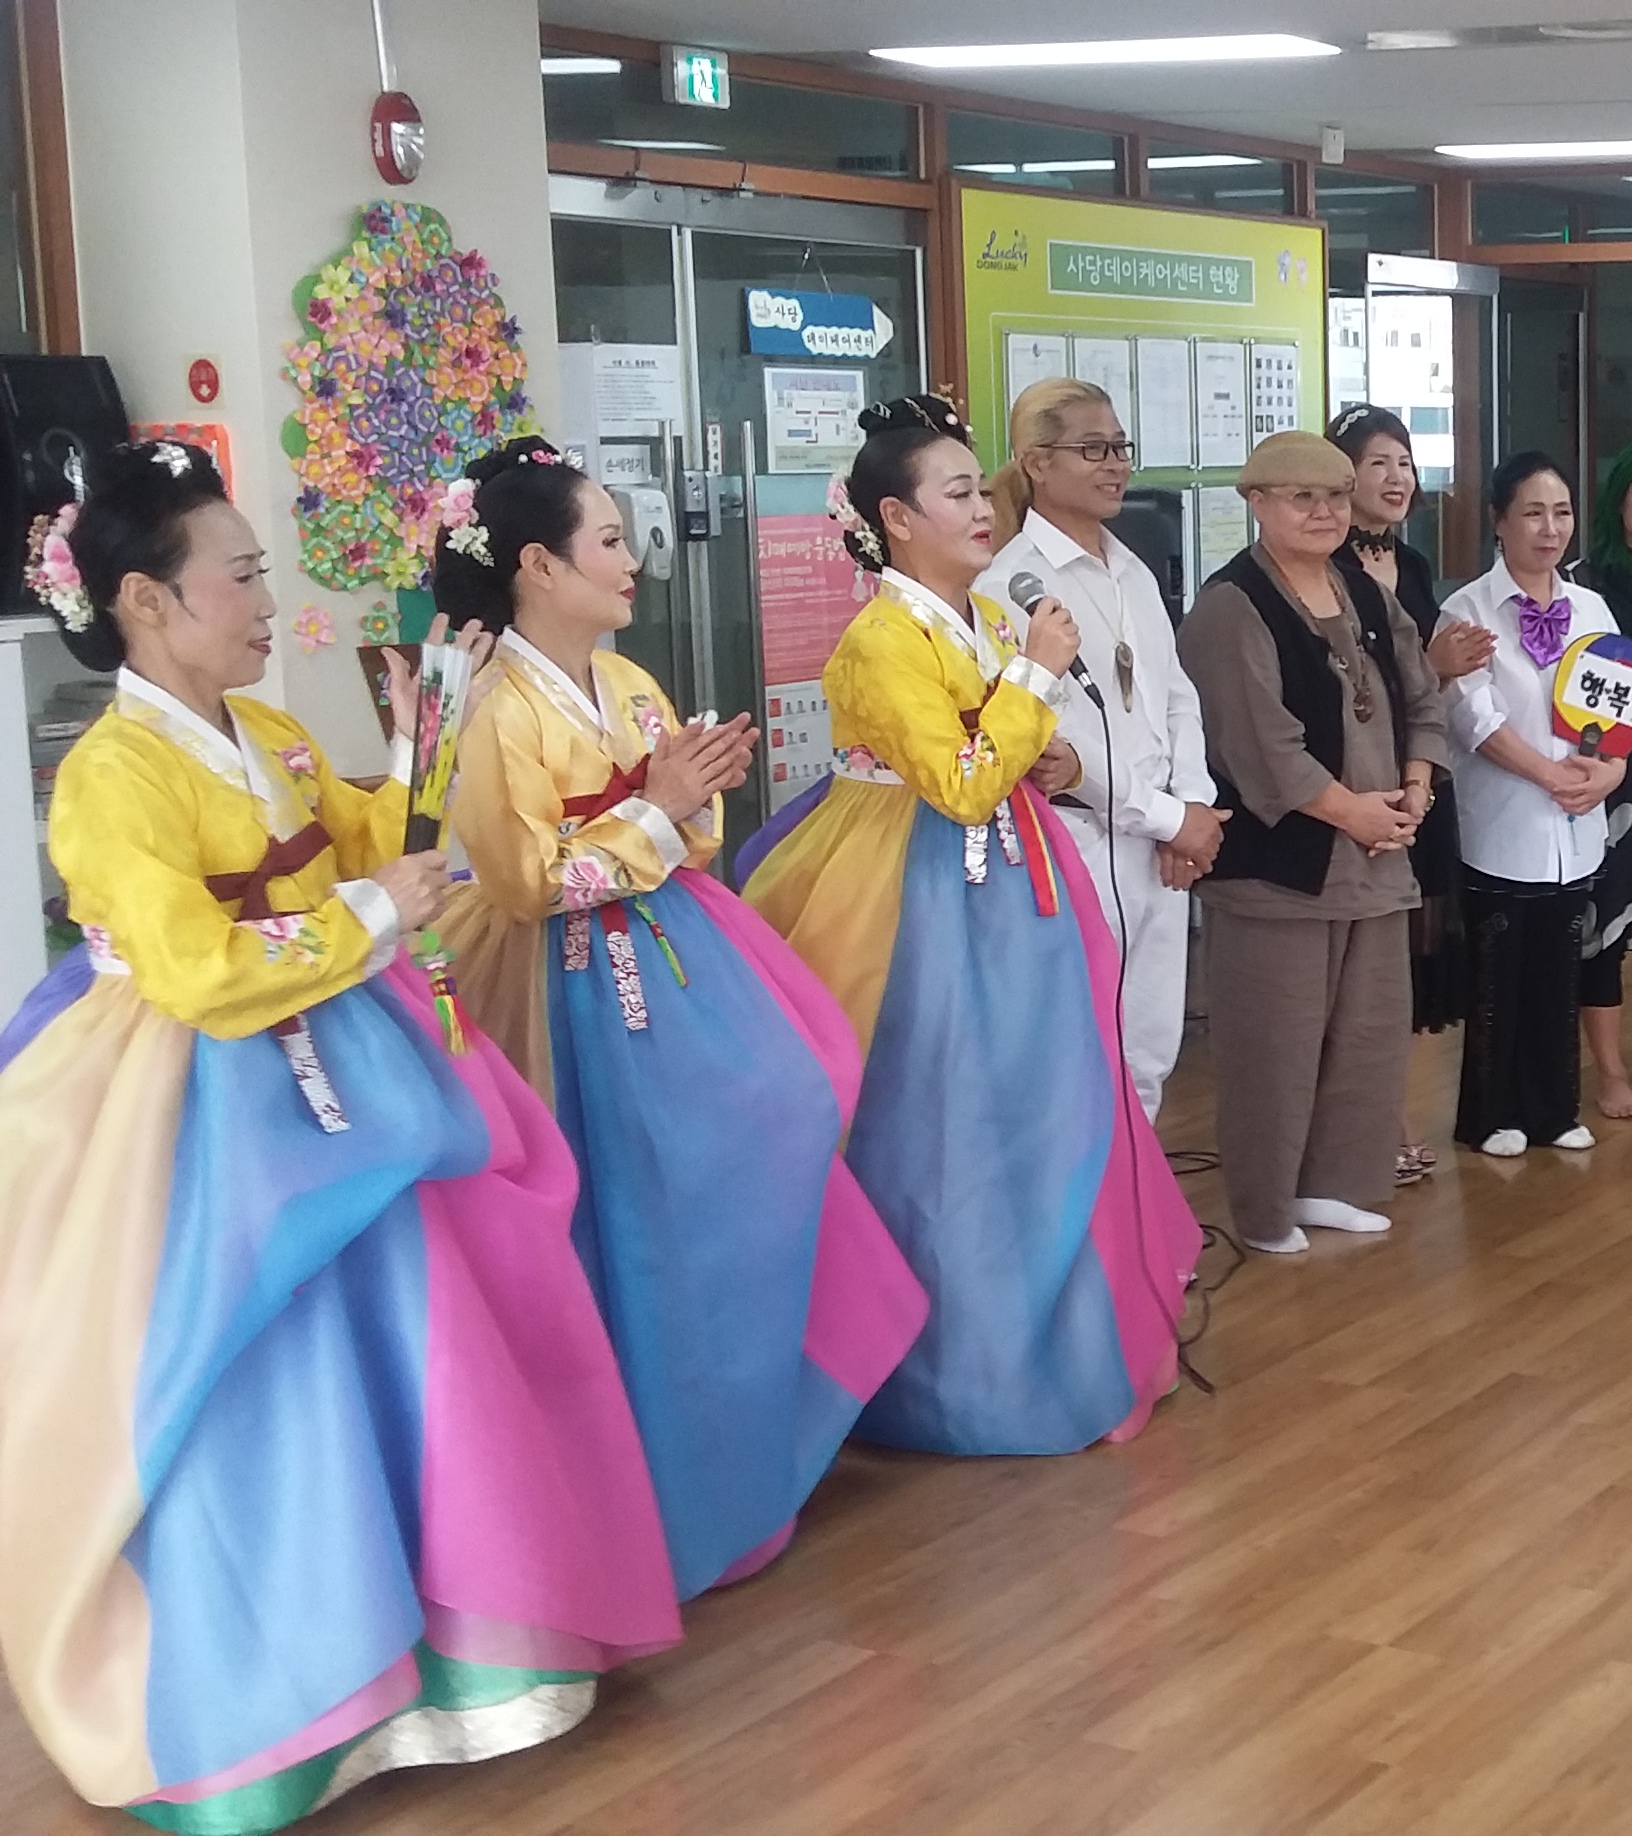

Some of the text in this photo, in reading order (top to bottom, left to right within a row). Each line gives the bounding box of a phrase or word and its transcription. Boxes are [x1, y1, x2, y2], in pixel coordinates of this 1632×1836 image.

[1066, 253, 1240, 296] 사당데이케어센터 현황
[806, 331, 874, 351] 데이케어센터
[1580, 668, 1632, 719] 행복
